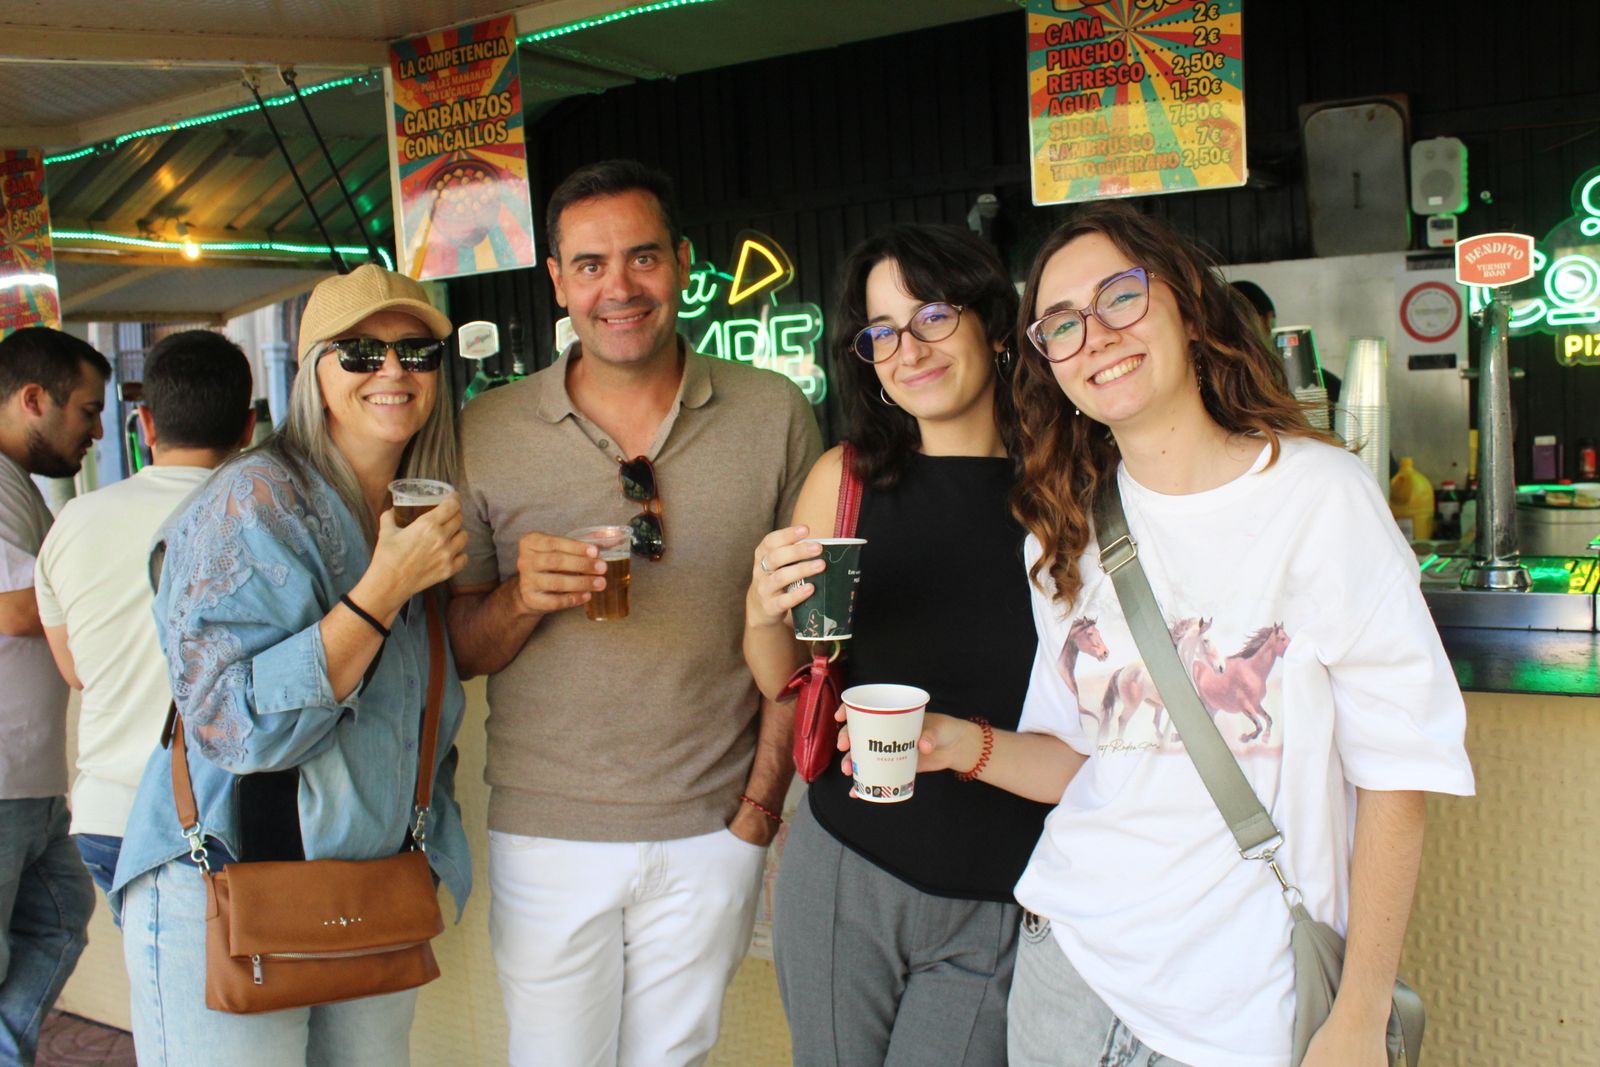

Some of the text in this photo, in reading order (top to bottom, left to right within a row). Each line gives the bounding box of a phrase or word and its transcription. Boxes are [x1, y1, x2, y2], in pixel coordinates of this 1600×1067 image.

[1192, 2, 1220, 24] 2€
[399, 37, 509, 79] LA COMPETENCIA
[1046, 26, 1221, 71] PINCHO 2€
[1046, 51, 1225, 95] REFRESCO 2,50€
[403, 91, 512, 137] GARBANZOS
[1048, 76, 1222, 117] AGUA 1,50€
[404, 120, 508, 160] CON CALLOS
[1049, 102, 1224, 142] SIDRA 7,50€
[1049, 126, 1222, 162] LAMBRUSCO 7€
[1051, 161, 1096, 182] TINTO
[1114, 151, 1181, 172] VERANO
[1183, 148, 1232, 169] 2,50€
[1465, 242, 1524, 264] BENDITO
[1483, 269, 1506, 278] ROJO
[868, 739, 915, 754] Mahou
